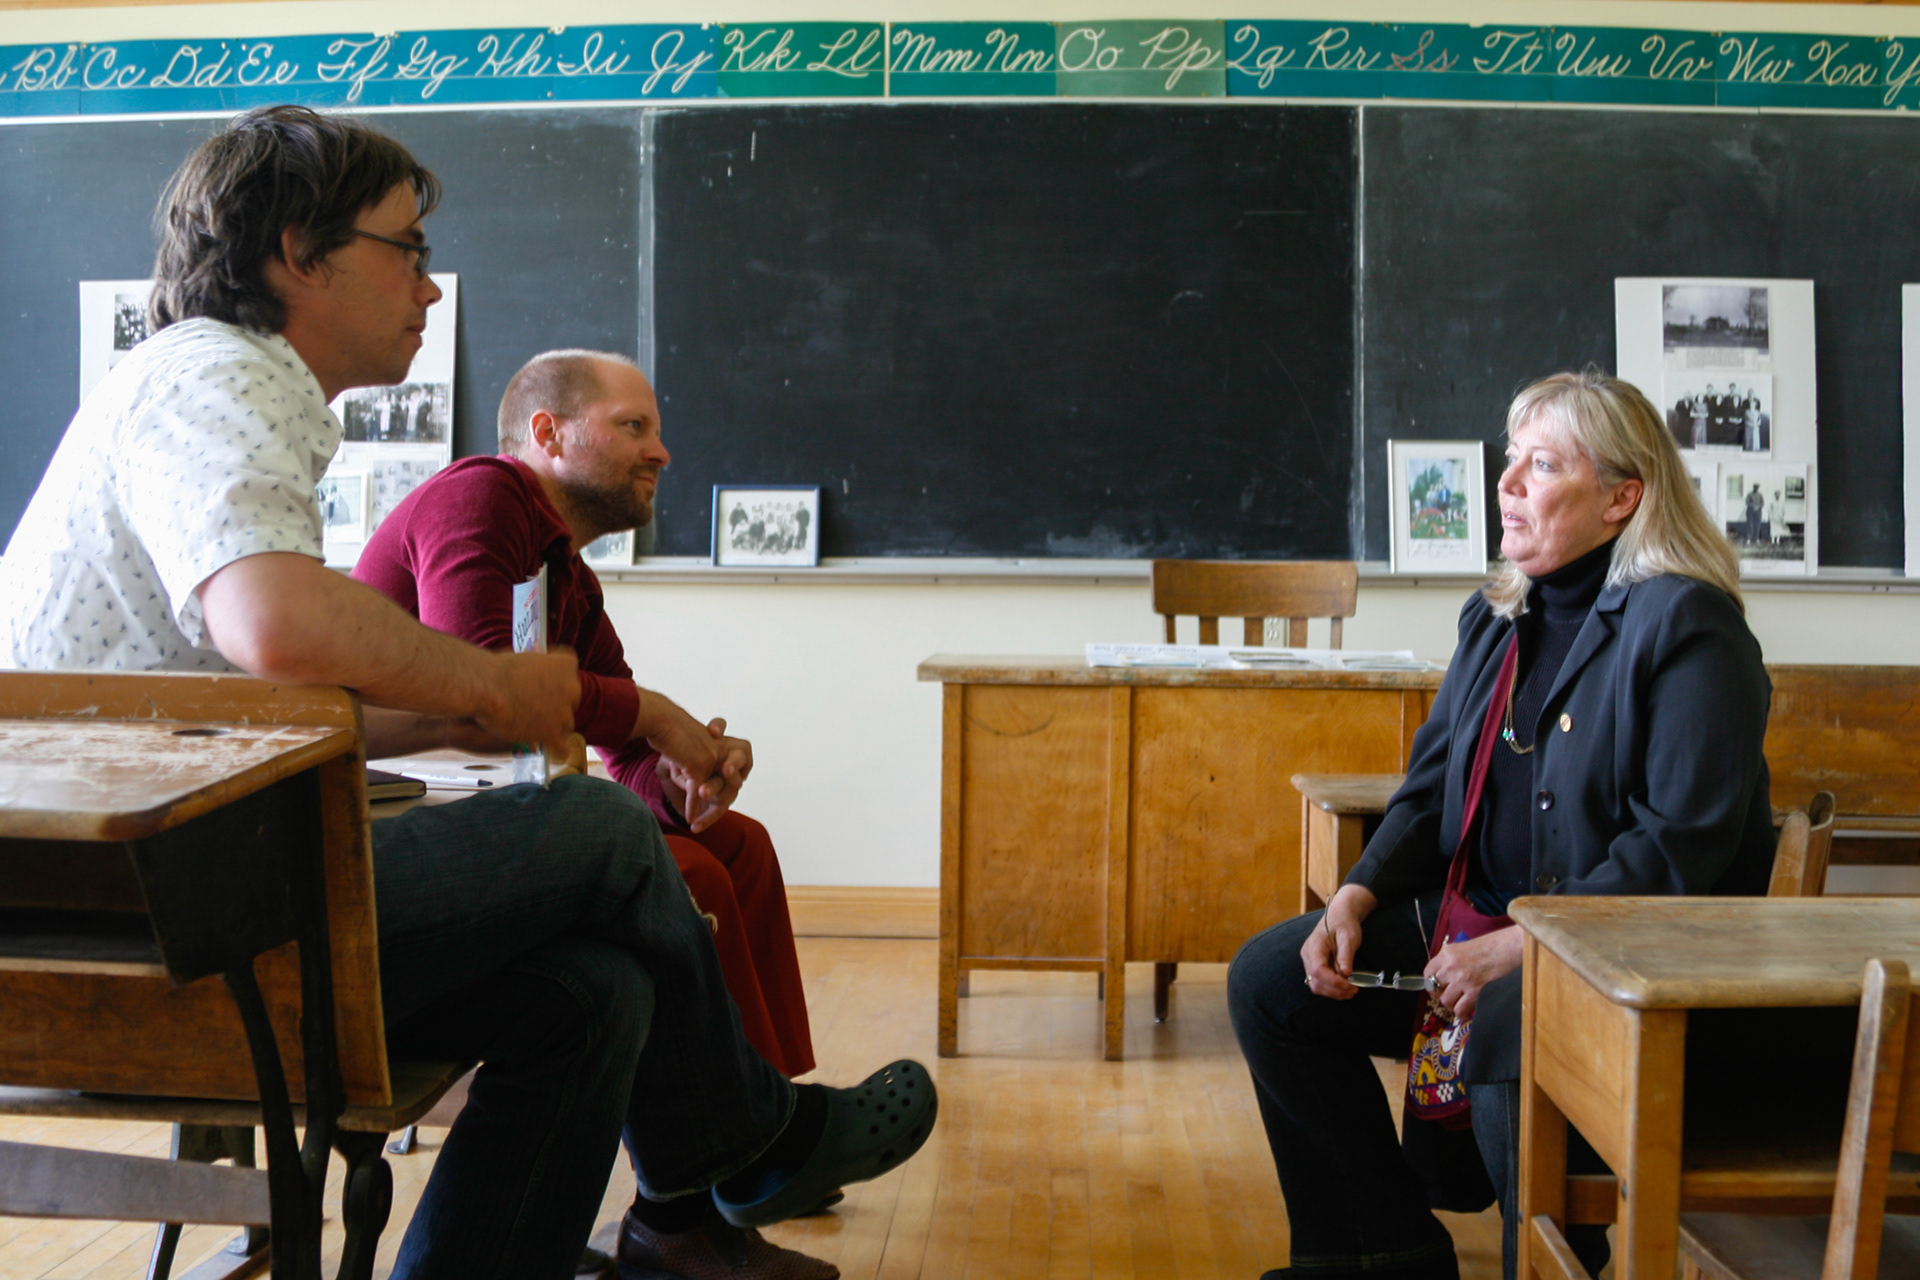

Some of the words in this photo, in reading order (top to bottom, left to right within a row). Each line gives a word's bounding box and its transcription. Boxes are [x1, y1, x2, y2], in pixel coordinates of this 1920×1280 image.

[12, 46, 78, 91] Bb
[84, 47, 146, 90] Cc
[151, 45, 233, 87] Dd
[238, 43, 299, 85] Ee
[317, 38, 391, 101] Ff
[393, 36, 469, 98] Gg
[475, 33, 551, 77] Hh
[556, 31, 630, 75] Ii
[641, 29, 714, 94] Jj
[721, 28, 801, 72] Kk
[806, 28, 881, 77] Ll
[890, 28, 982, 73] Mm
[984, 28, 1054, 73] Nn
[1059, 27, 1124, 72] Oo
[1139, 26, 1221, 91] Pp
[1304, 26, 1381, 71] Rr
[1473, 30, 1544, 75] Tt
[1555, 32, 1631, 77] Uu
[1641, 34, 1713, 81] Vv
[1719, 37, 1795, 83] Ww
[1804, 39, 1878, 87] Xx
